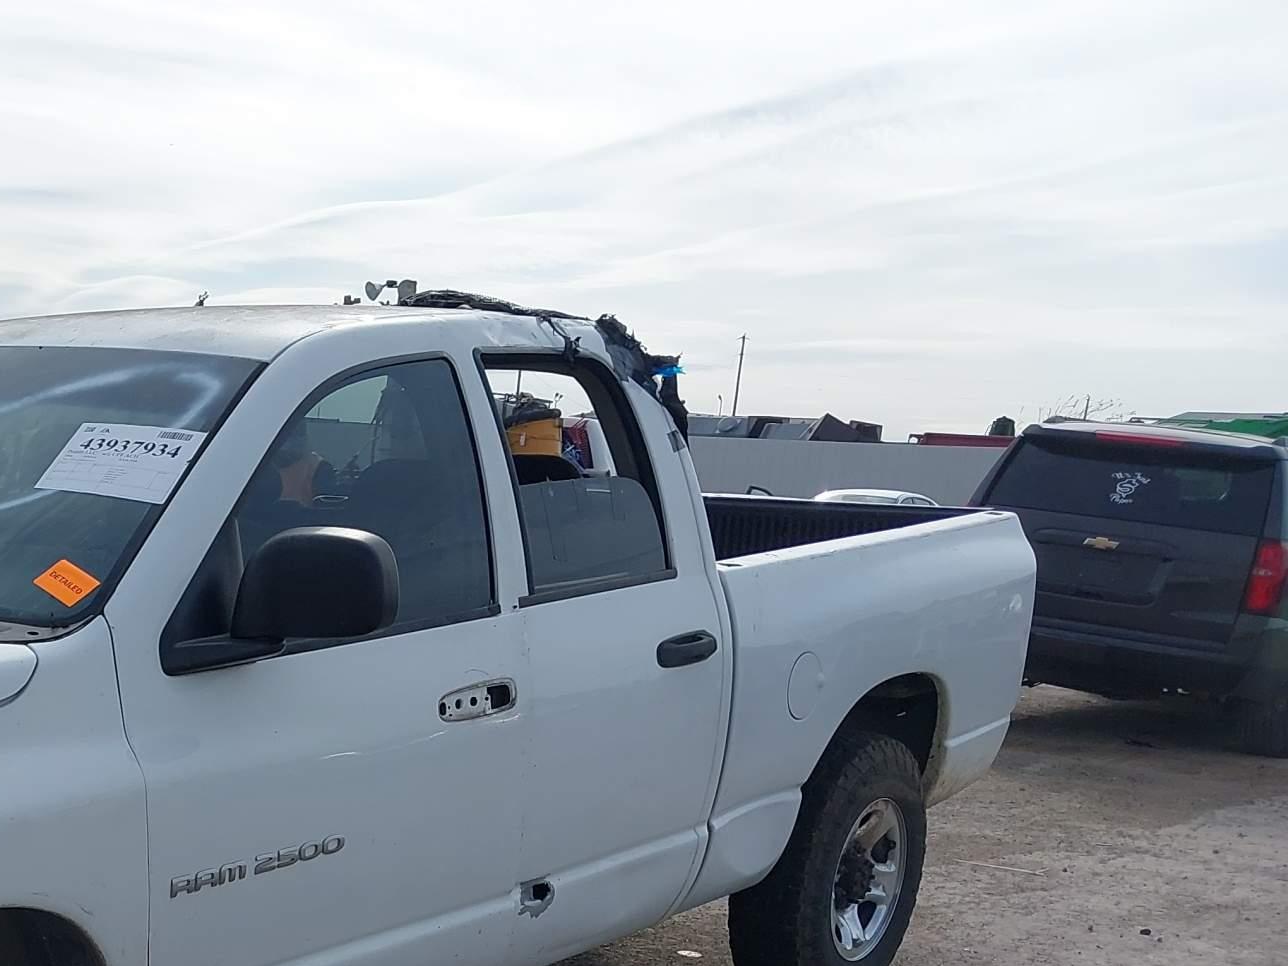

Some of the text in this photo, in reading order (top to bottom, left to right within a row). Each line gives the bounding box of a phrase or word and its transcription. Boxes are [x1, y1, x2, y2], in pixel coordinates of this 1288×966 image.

[79, 438, 182, 459] 43937934
[49, 570, 83, 595] DETAILED
[169, 833, 346, 898] RAM 2500
